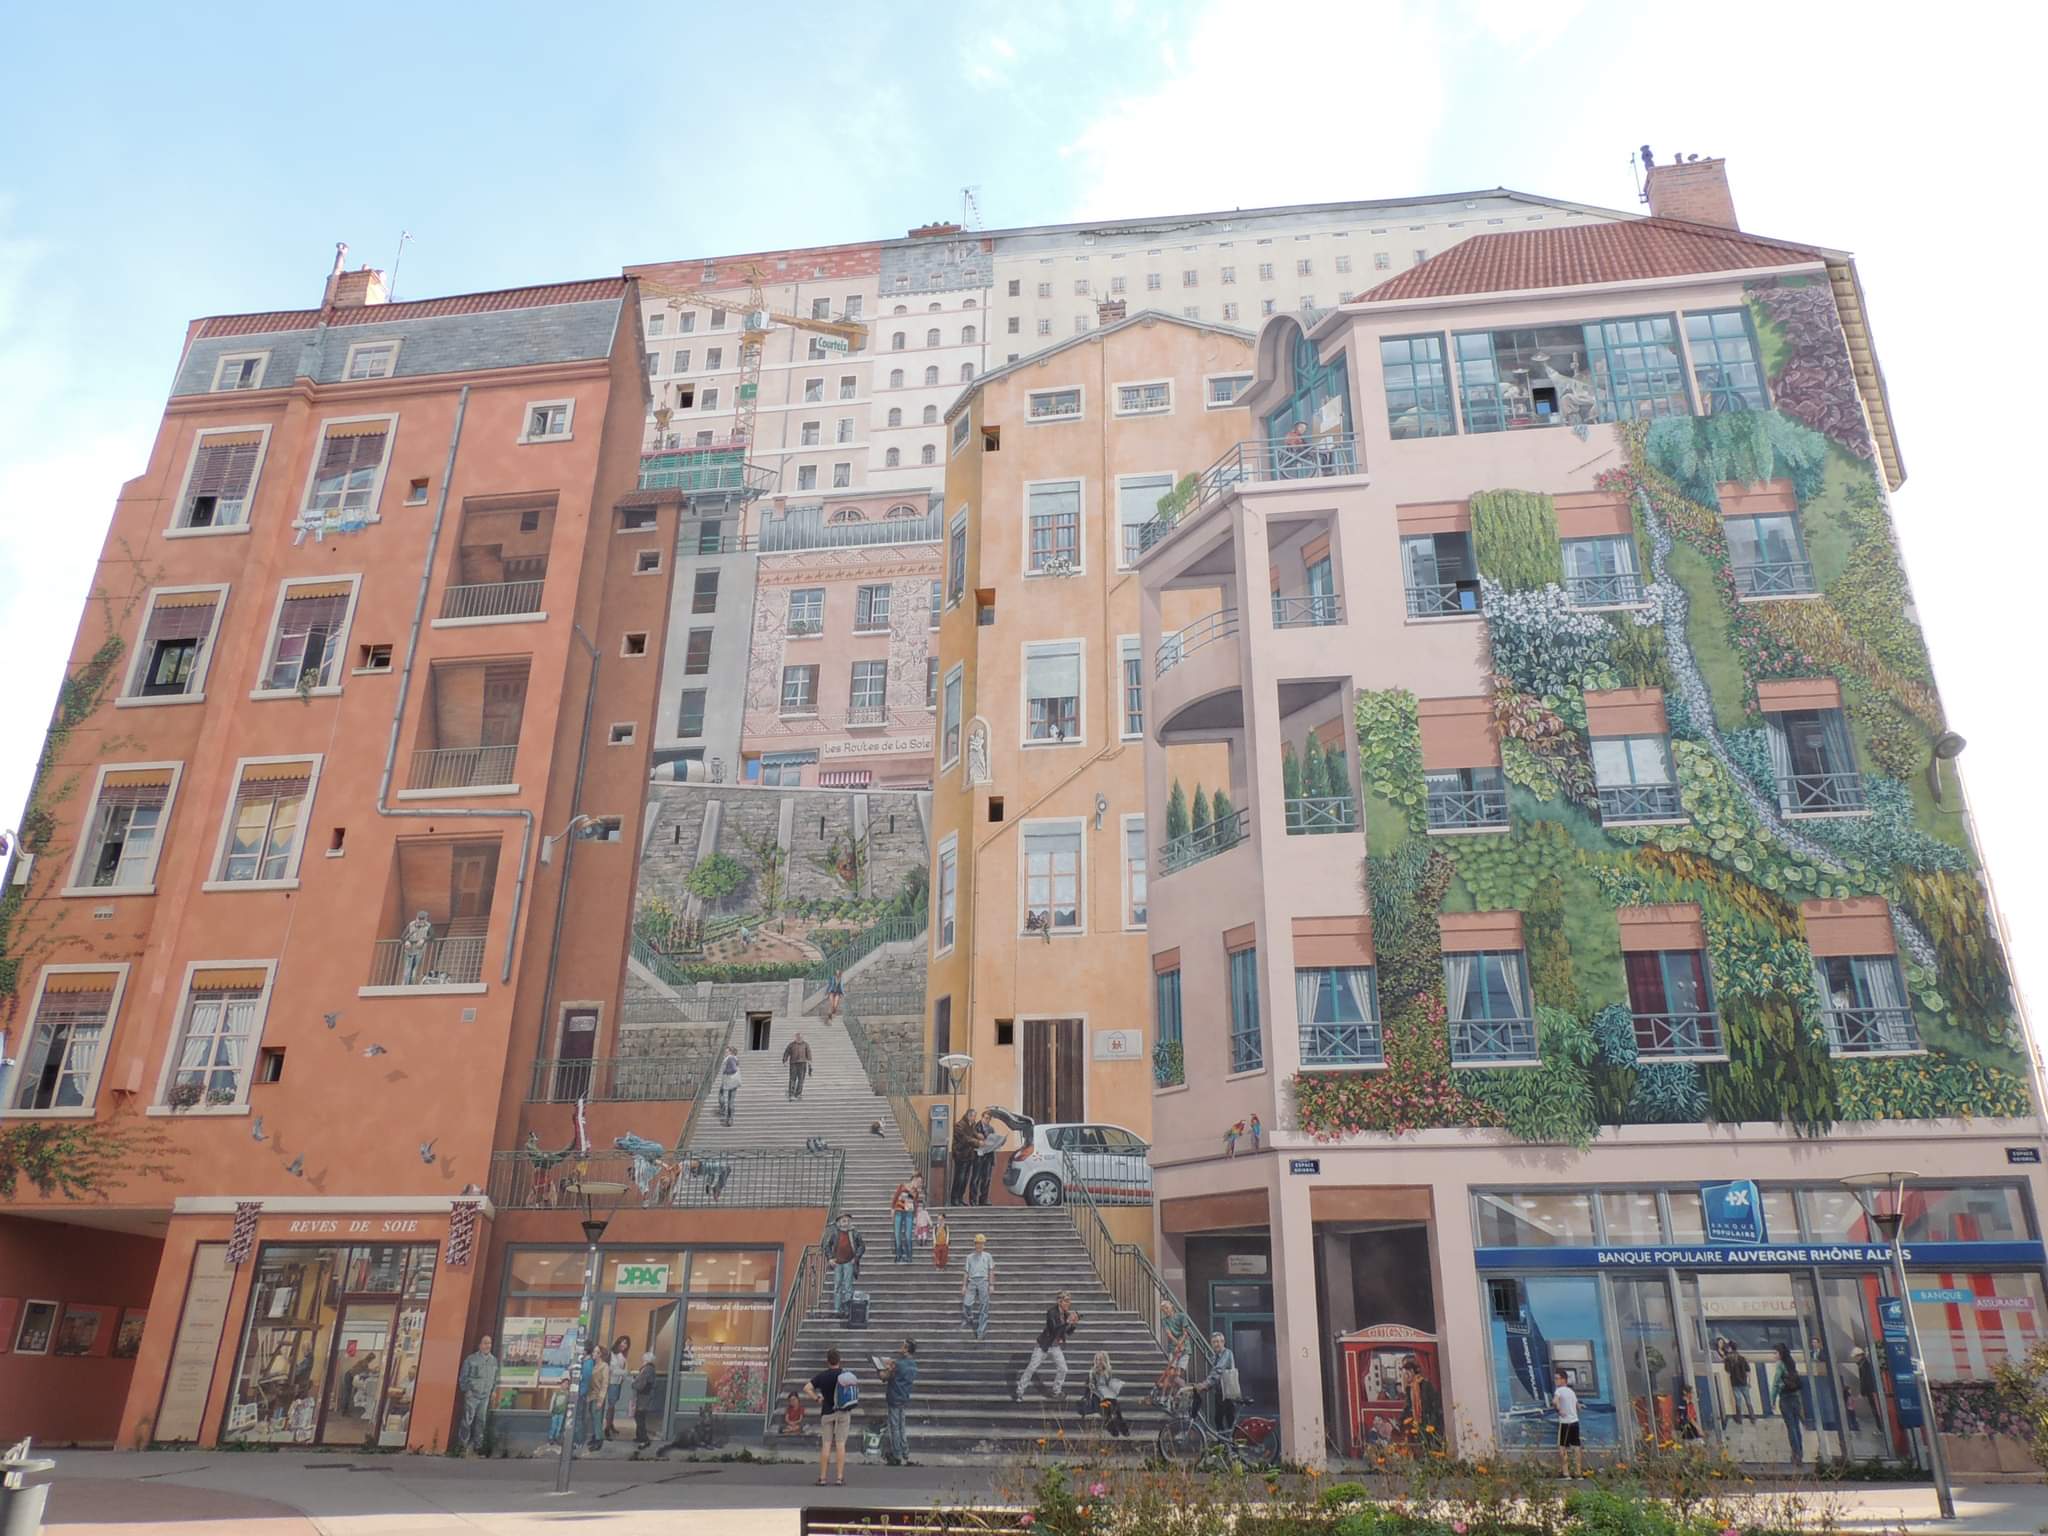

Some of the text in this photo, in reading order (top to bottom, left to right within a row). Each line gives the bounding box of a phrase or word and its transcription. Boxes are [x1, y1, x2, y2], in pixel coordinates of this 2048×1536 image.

[824, 738, 930, 753] Les Routes de La Soie
[289, 1220, 418, 1233] REVES DE SOIE
[1712, 1229, 1756, 1238] POPULAIRE
[1598, 1247, 1912, 1264] BANQUE POPULAIRE AUVERGNE RHÔNE ALPS
[1919, 1290, 1963, 1300] BANQUE
[1976, 1297, 2029, 1307] ASSURANCE
[1302, 1346, 1309, 1358] 3
